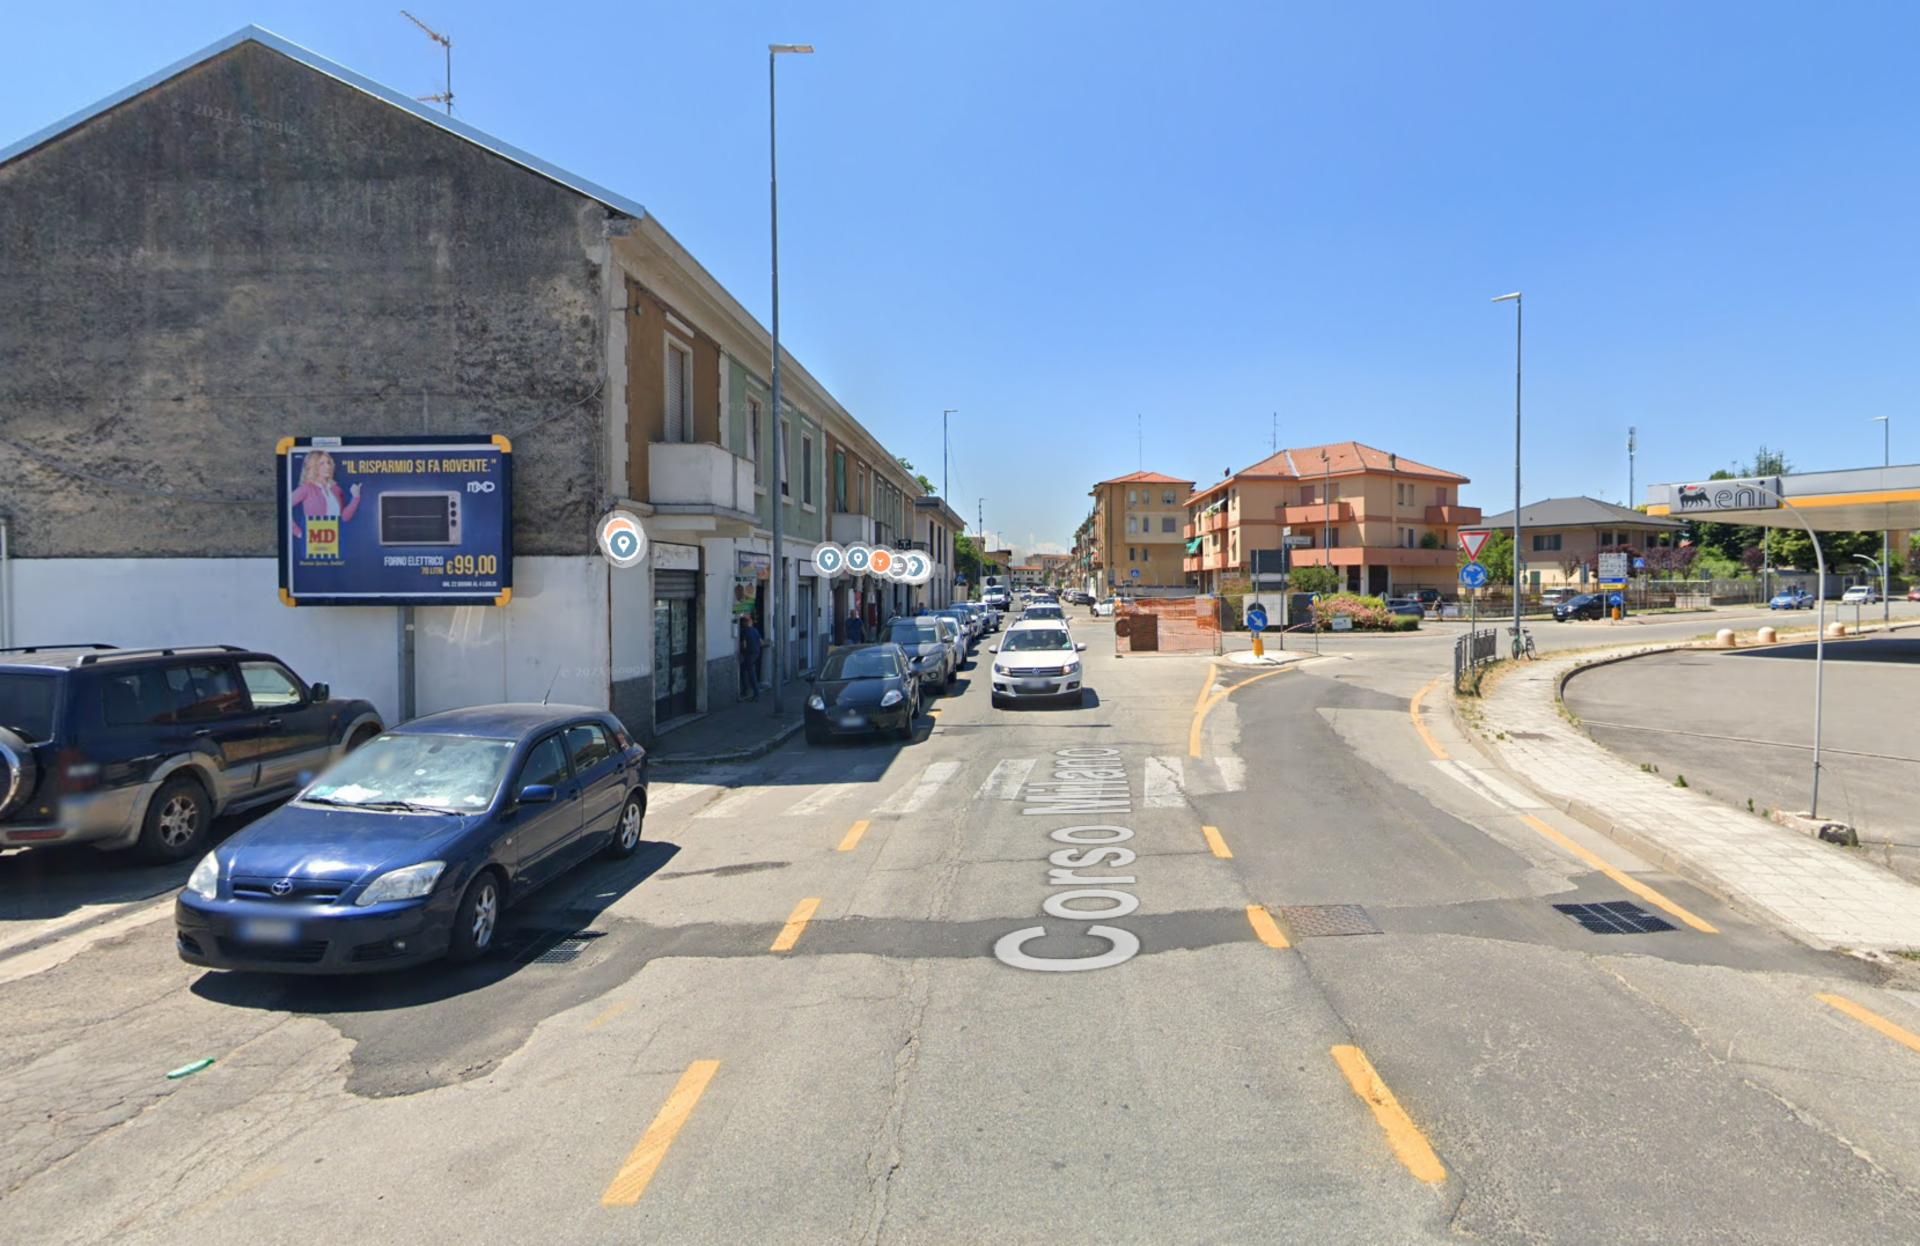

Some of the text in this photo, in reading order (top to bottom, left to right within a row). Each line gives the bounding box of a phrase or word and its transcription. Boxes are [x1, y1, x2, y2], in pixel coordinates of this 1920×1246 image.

[358, 459, 414, 474] RISPARMIO
[415, 459, 425, 473] SI
[428, 458, 441, 473] FA
[1714, 478, 1767, 508] eni
[308, 528, 336, 545] MD
[408, 555, 445, 567] ELETTRICO
[446, 554, 497, 577] €99,00
